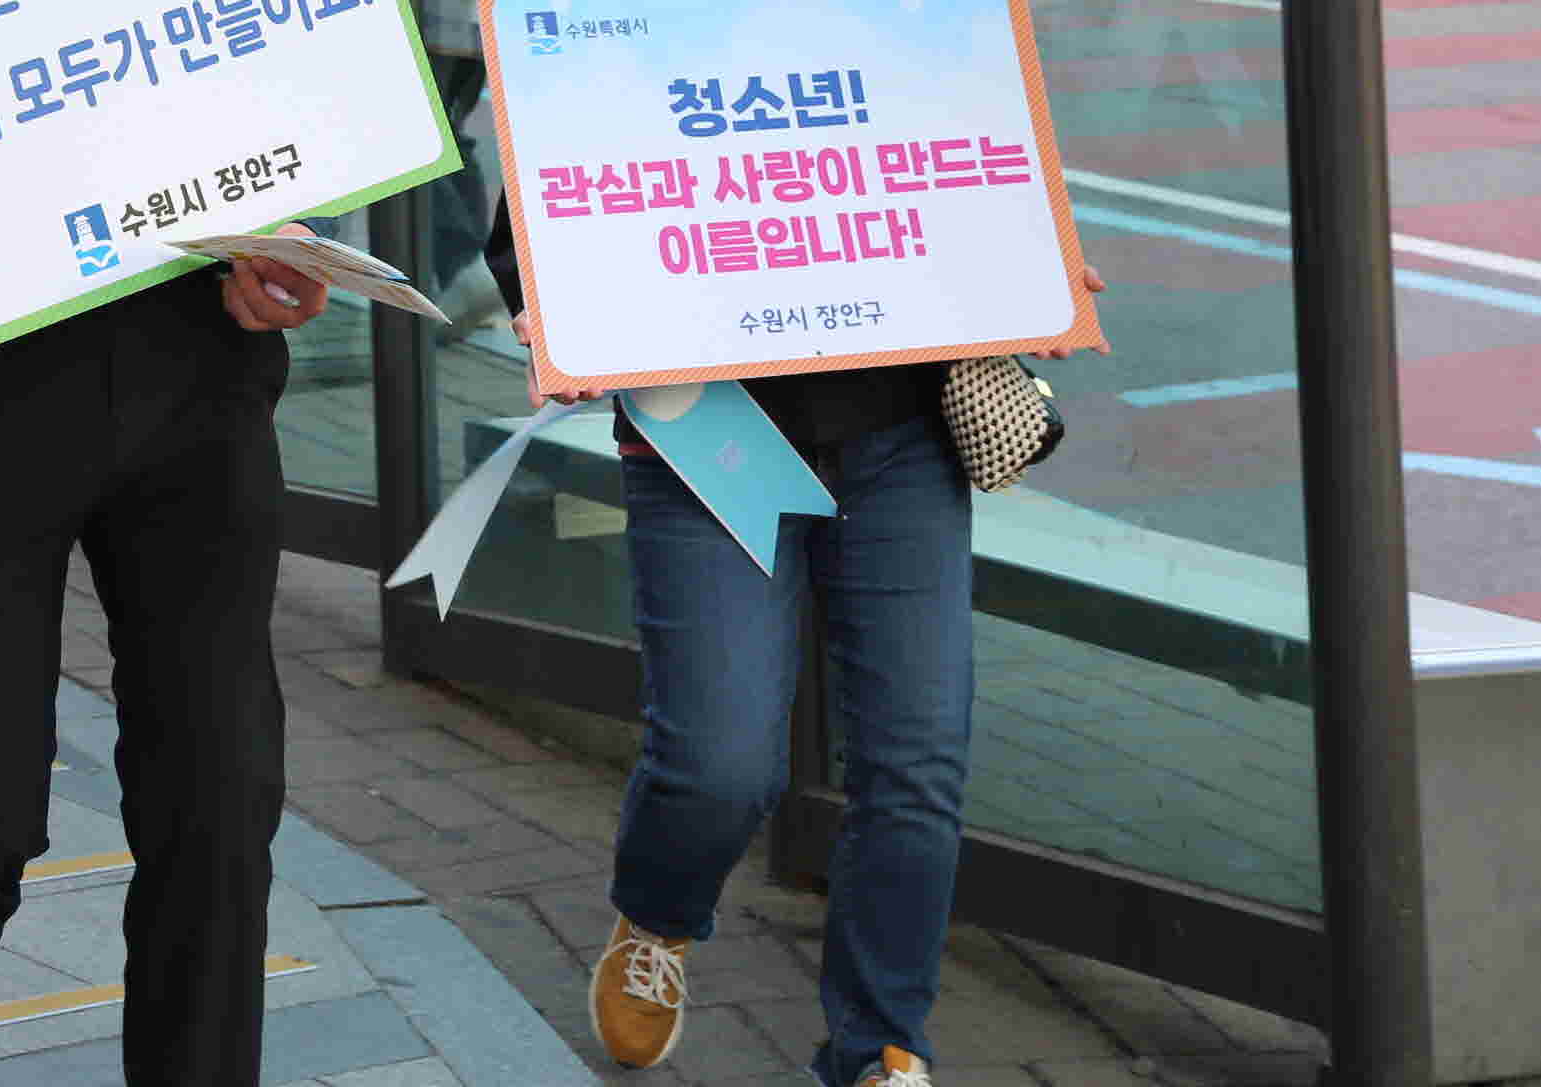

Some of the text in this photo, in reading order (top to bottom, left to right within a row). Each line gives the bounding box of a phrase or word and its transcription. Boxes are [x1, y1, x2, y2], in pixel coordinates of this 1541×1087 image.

[566, 18, 649, 40] 수원특례시
[9, 21, 159, 123] 모두가
[667, 70, 869, 137] 청소년!
[119, 144, 302, 237] 수원시 장안구
[538, 135, 1031, 218] 관심과 사랑이 만드는
[660, 208, 926, 275] 이름입니다!
[739, 301, 885, 334] 수원시 장안구
